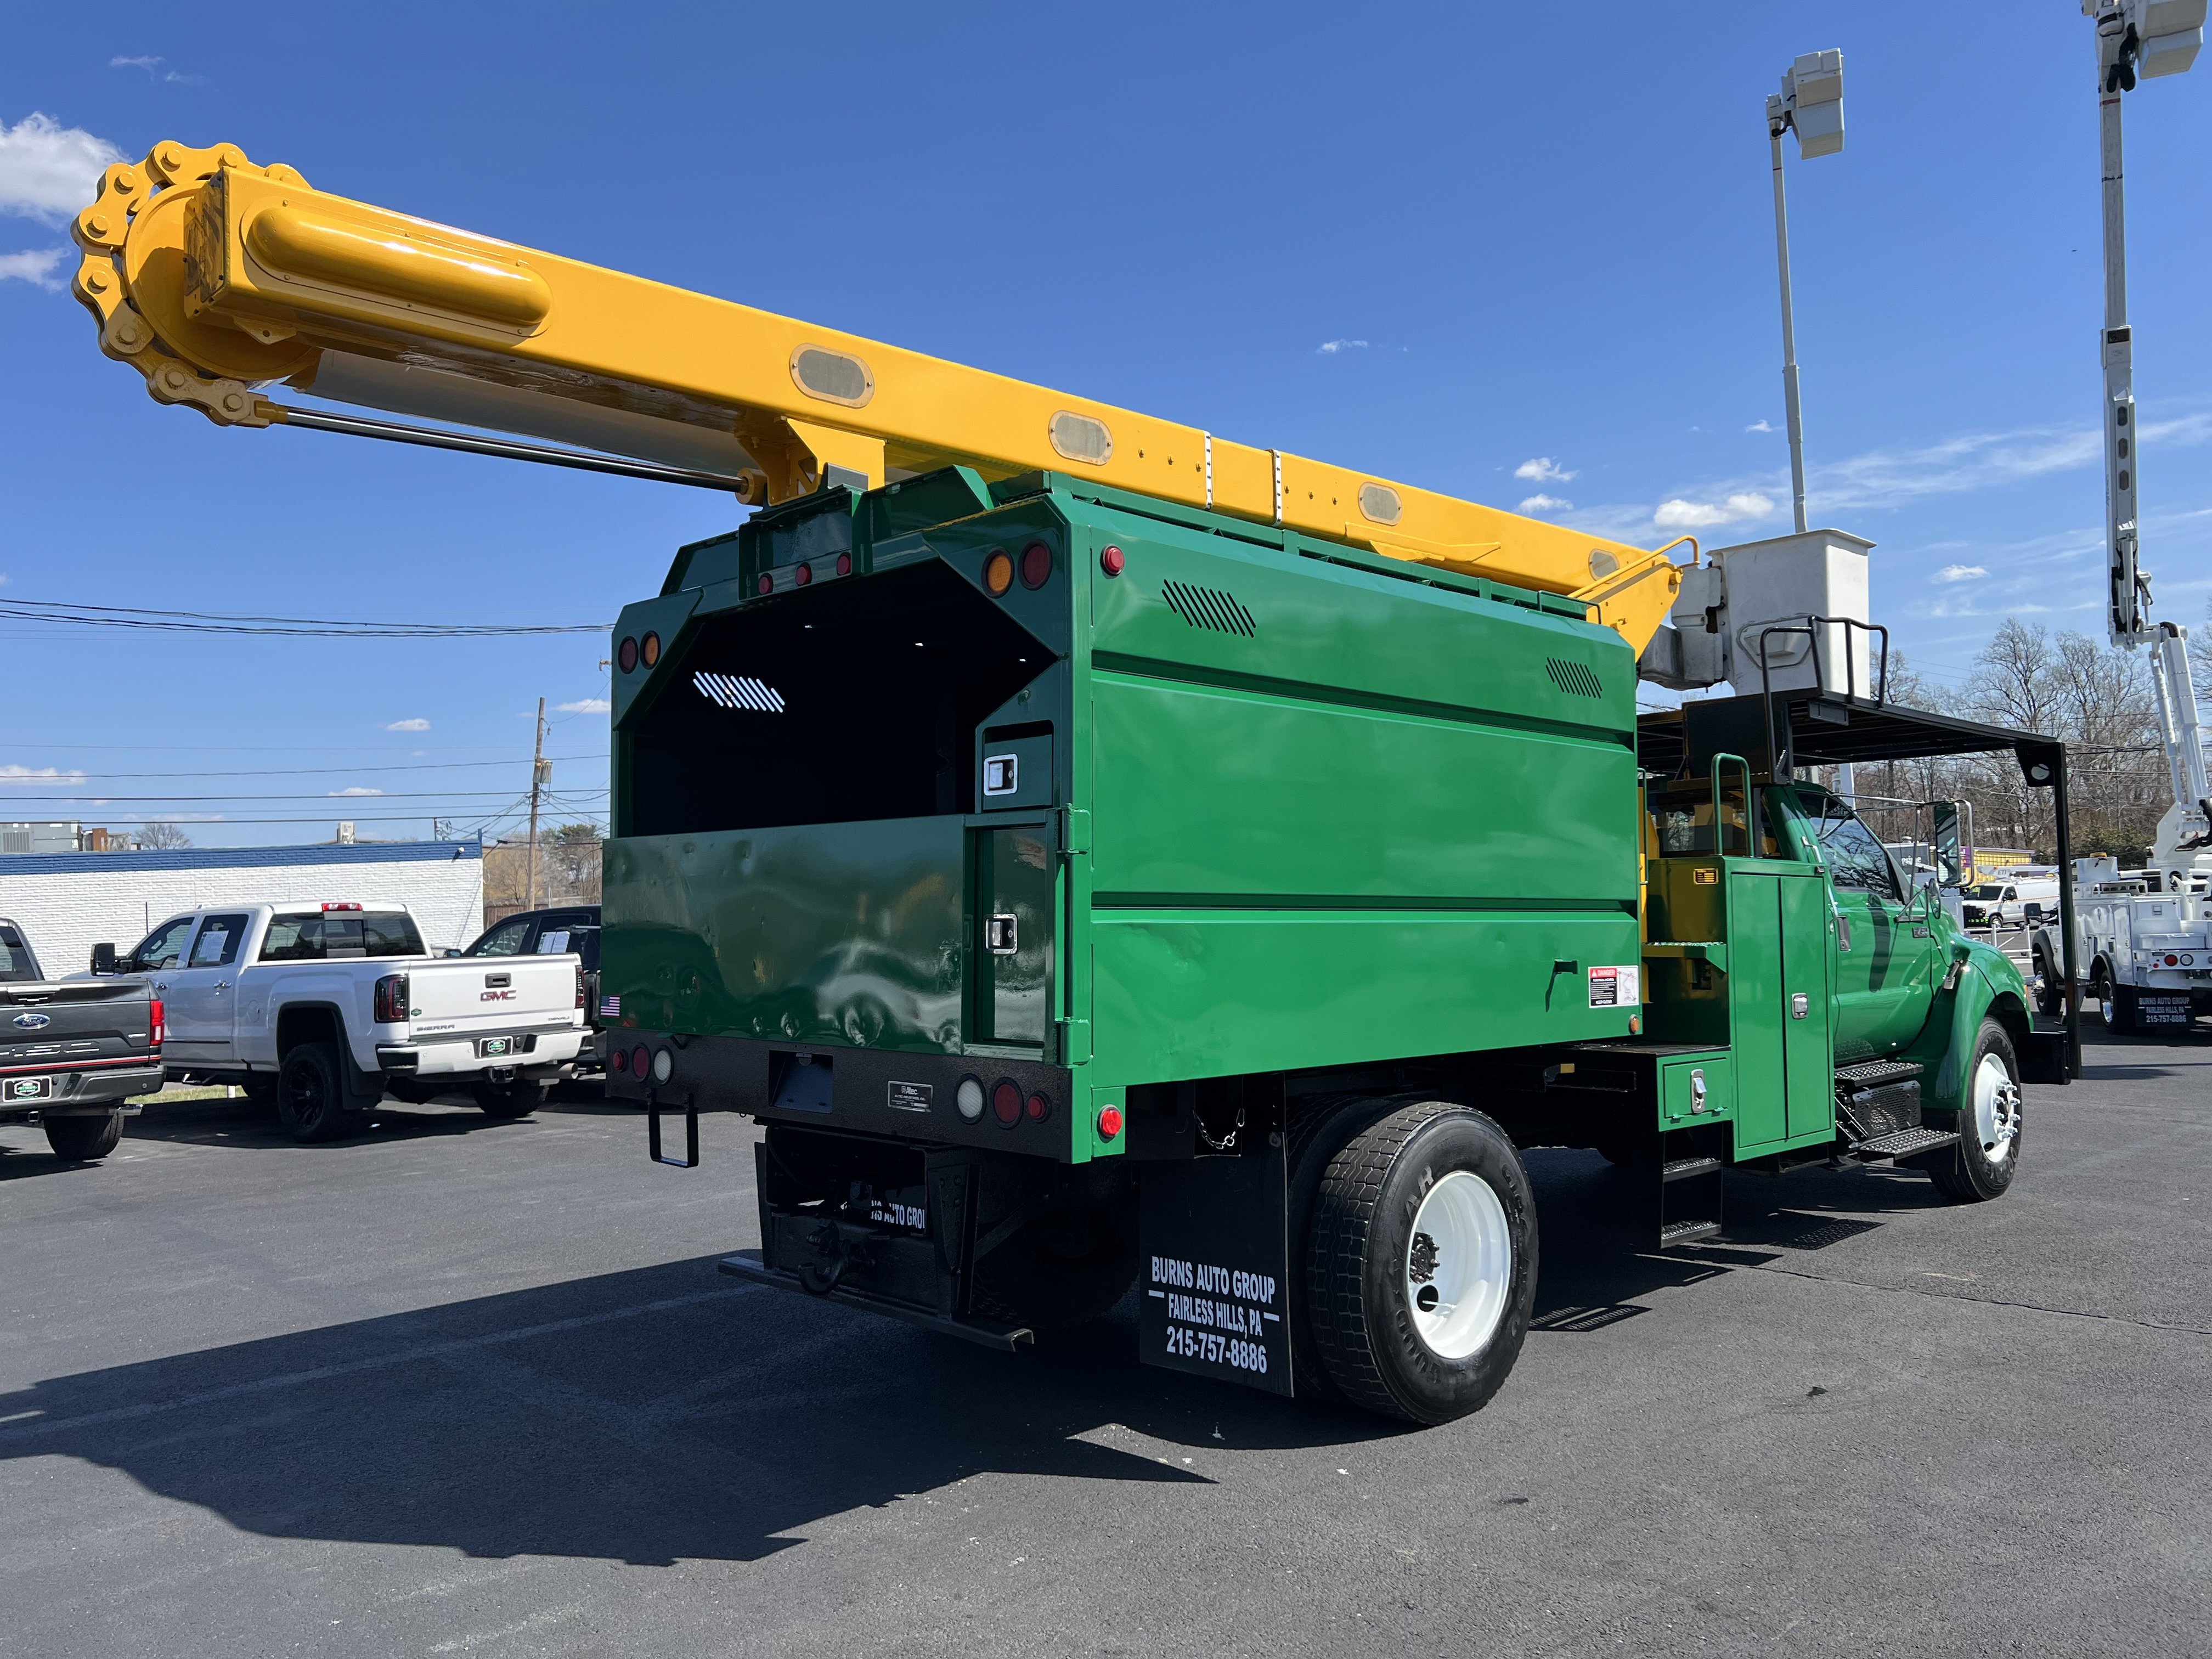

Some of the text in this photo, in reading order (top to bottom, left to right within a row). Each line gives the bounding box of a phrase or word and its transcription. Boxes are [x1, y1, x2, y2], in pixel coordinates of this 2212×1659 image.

[481, 990, 517, 1002] GMC
[1152, 1256, 1276, 1304] BURNS AUTO GROUP
[1169, 1293, 1263, 1339] FAIRLESS HILLS, PA
[1166, 1325, 1267, 1374] 215-757-8886
